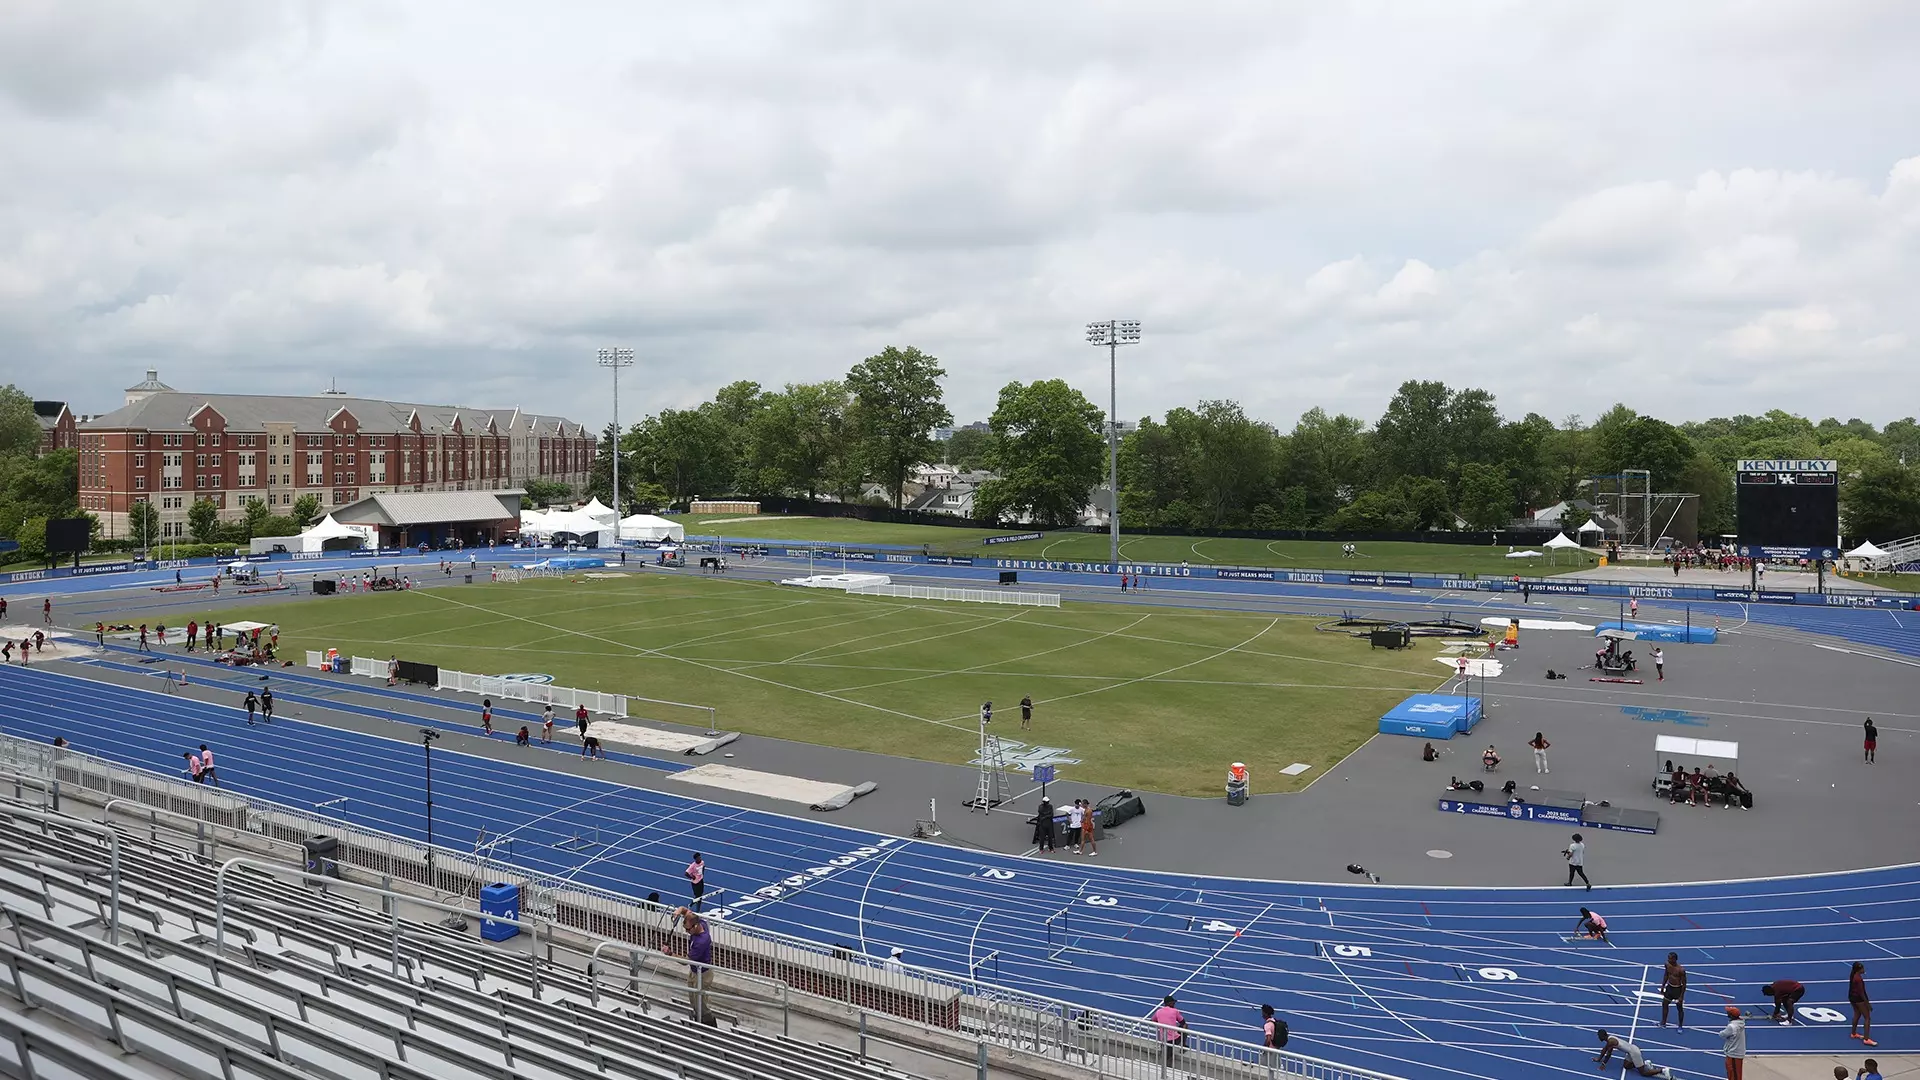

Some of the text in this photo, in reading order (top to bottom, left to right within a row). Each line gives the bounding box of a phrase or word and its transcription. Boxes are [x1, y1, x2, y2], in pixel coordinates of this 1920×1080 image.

[1743, 461, 1831, 470] KENTUCKY
[291, 552, 323, 560] KENTUCKY
[1117, 565, 1142, 574] AND
[1151, 566, 1190, 576] FIELD
[11, 571, 45, 582] KENTUCKY
[1288, 573, 1323, 582] WILDCATS
[1628, 587, 1673, 597] WILDCATS
[1457, 803, 1465, 812] 2
[1472, 808, 1506, 816] CHAMPIONSHIPS
[1528, 808, 1533, 818] 1
[1538, 813, 1578, 822] CHAMPIONSHIPS
[876, 838, 898, 847] 1
[848, 847, 880, 857] 2
[828, 856, 857, 866] 3
[805, 866, 836, 876] 4
[982, 869, 1015, 880] 2
[781, 875, 813, 886] 5
[1086, 896, 1118, 906] 3
[1203, 920, 1237, 931] 4
[1334, 944, 1371, 957] 5
[1478, 967, 1518, 981] 6
[1797, 1007, 1847, 1022] 8
